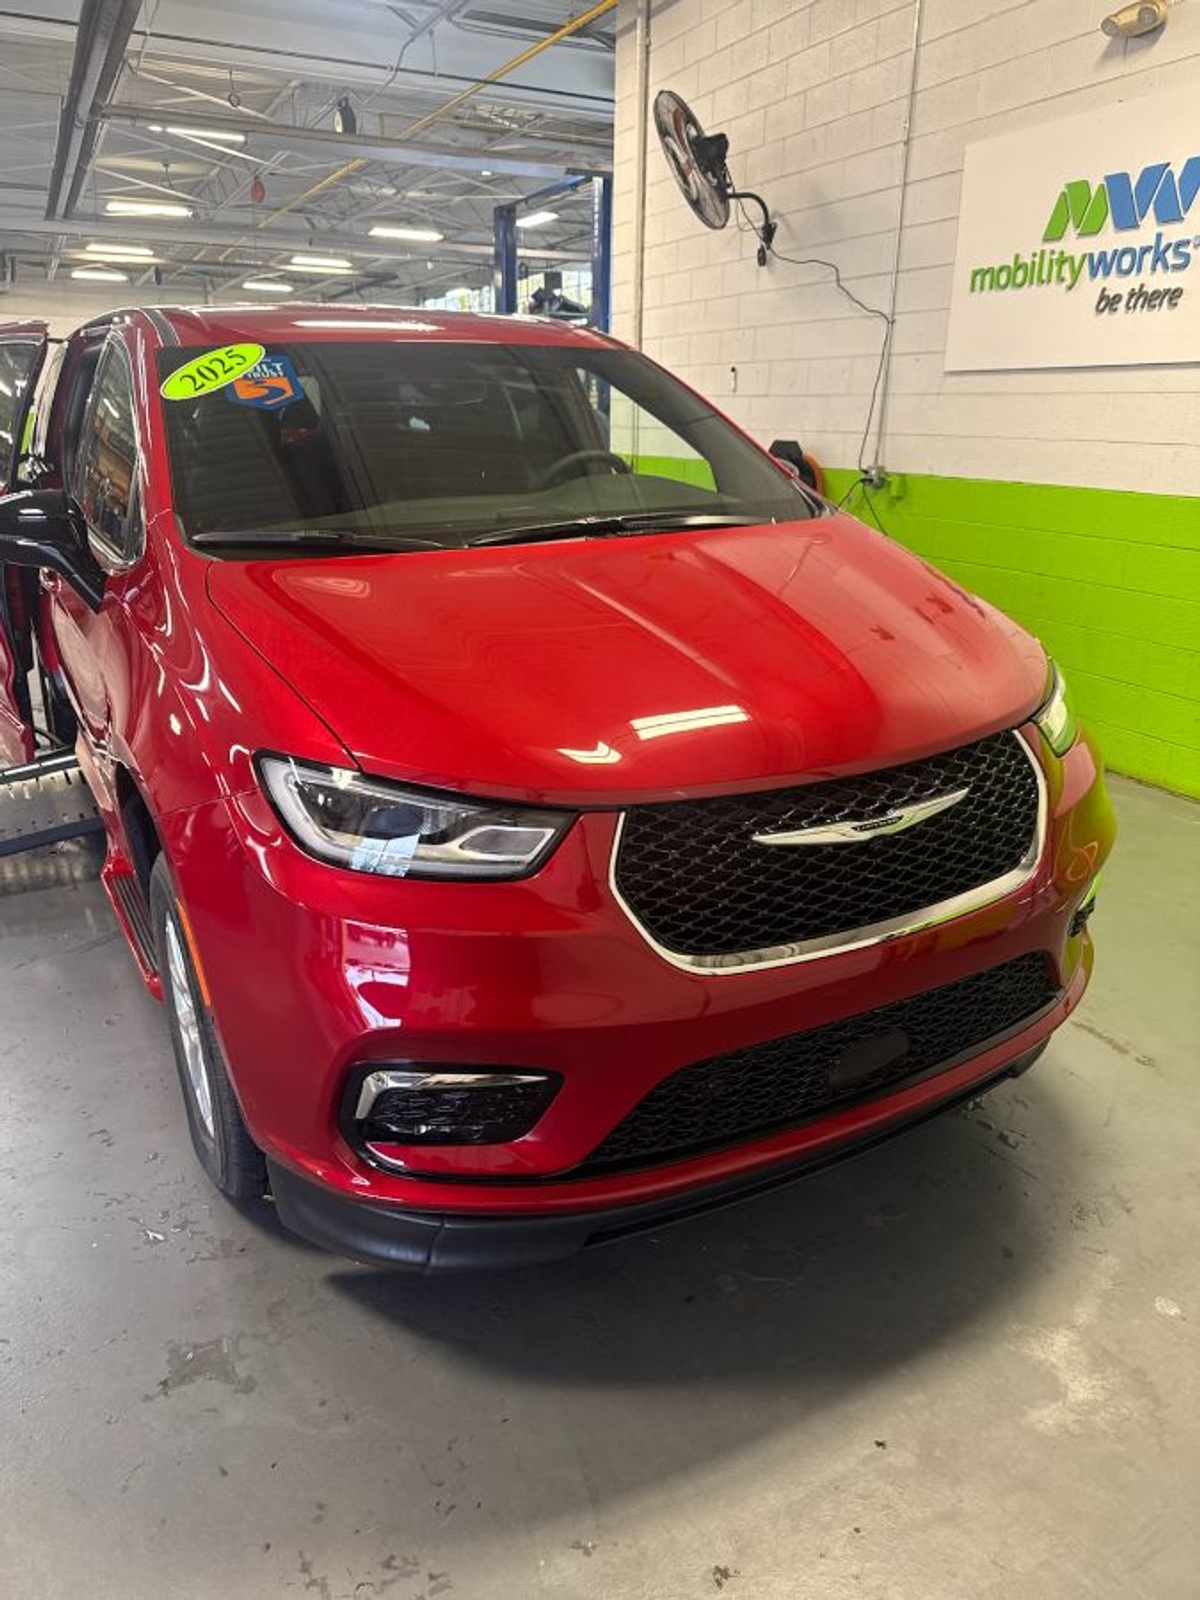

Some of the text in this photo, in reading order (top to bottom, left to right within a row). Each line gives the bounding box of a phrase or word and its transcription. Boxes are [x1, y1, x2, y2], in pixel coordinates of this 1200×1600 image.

[970, 231, 1192, 292] mobilityworks
[1095, 283, 1183, 314] be there
[179, 349, 246, 391] 2025
